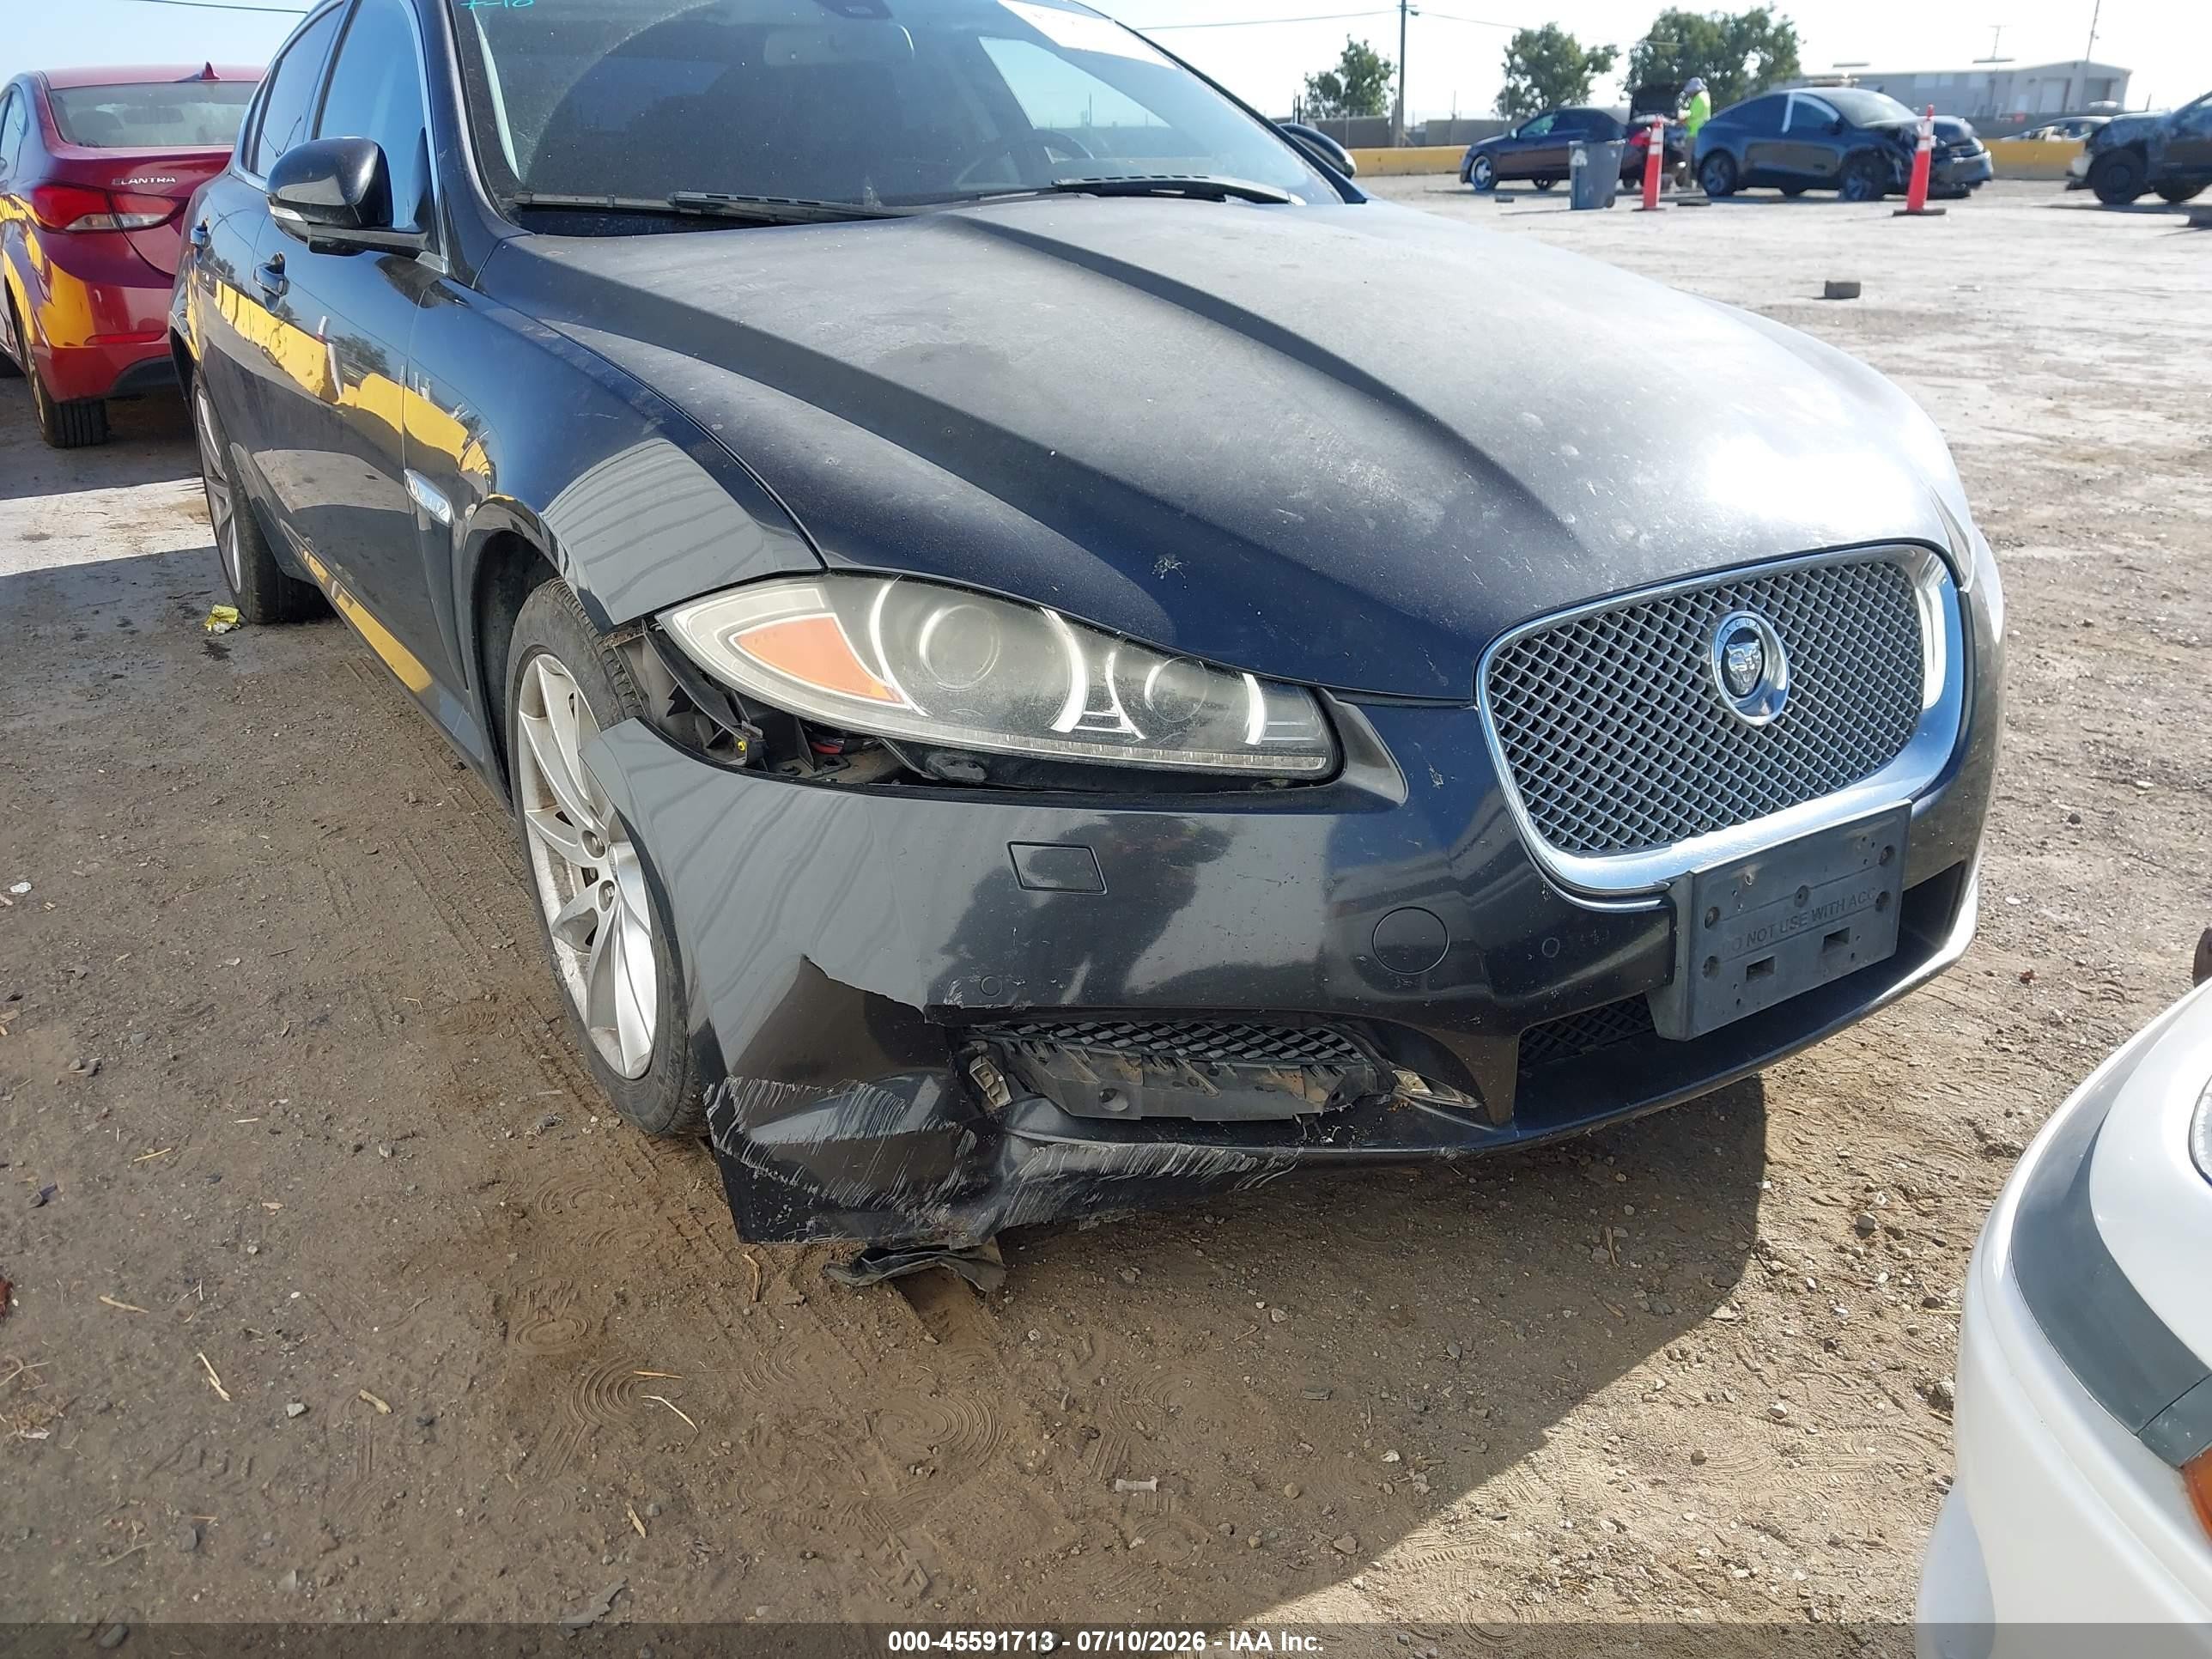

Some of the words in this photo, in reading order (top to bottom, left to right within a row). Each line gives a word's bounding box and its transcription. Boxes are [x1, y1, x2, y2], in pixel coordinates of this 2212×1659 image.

[111, 177, 176, 185] ELANTRA
[1718, 618, 1759, 646] JAGUA
[1747, 922, 1776, 946] NOT
[1779, 911, 1808, 933] USE
[1812, 898, 1844, 921] WITH
